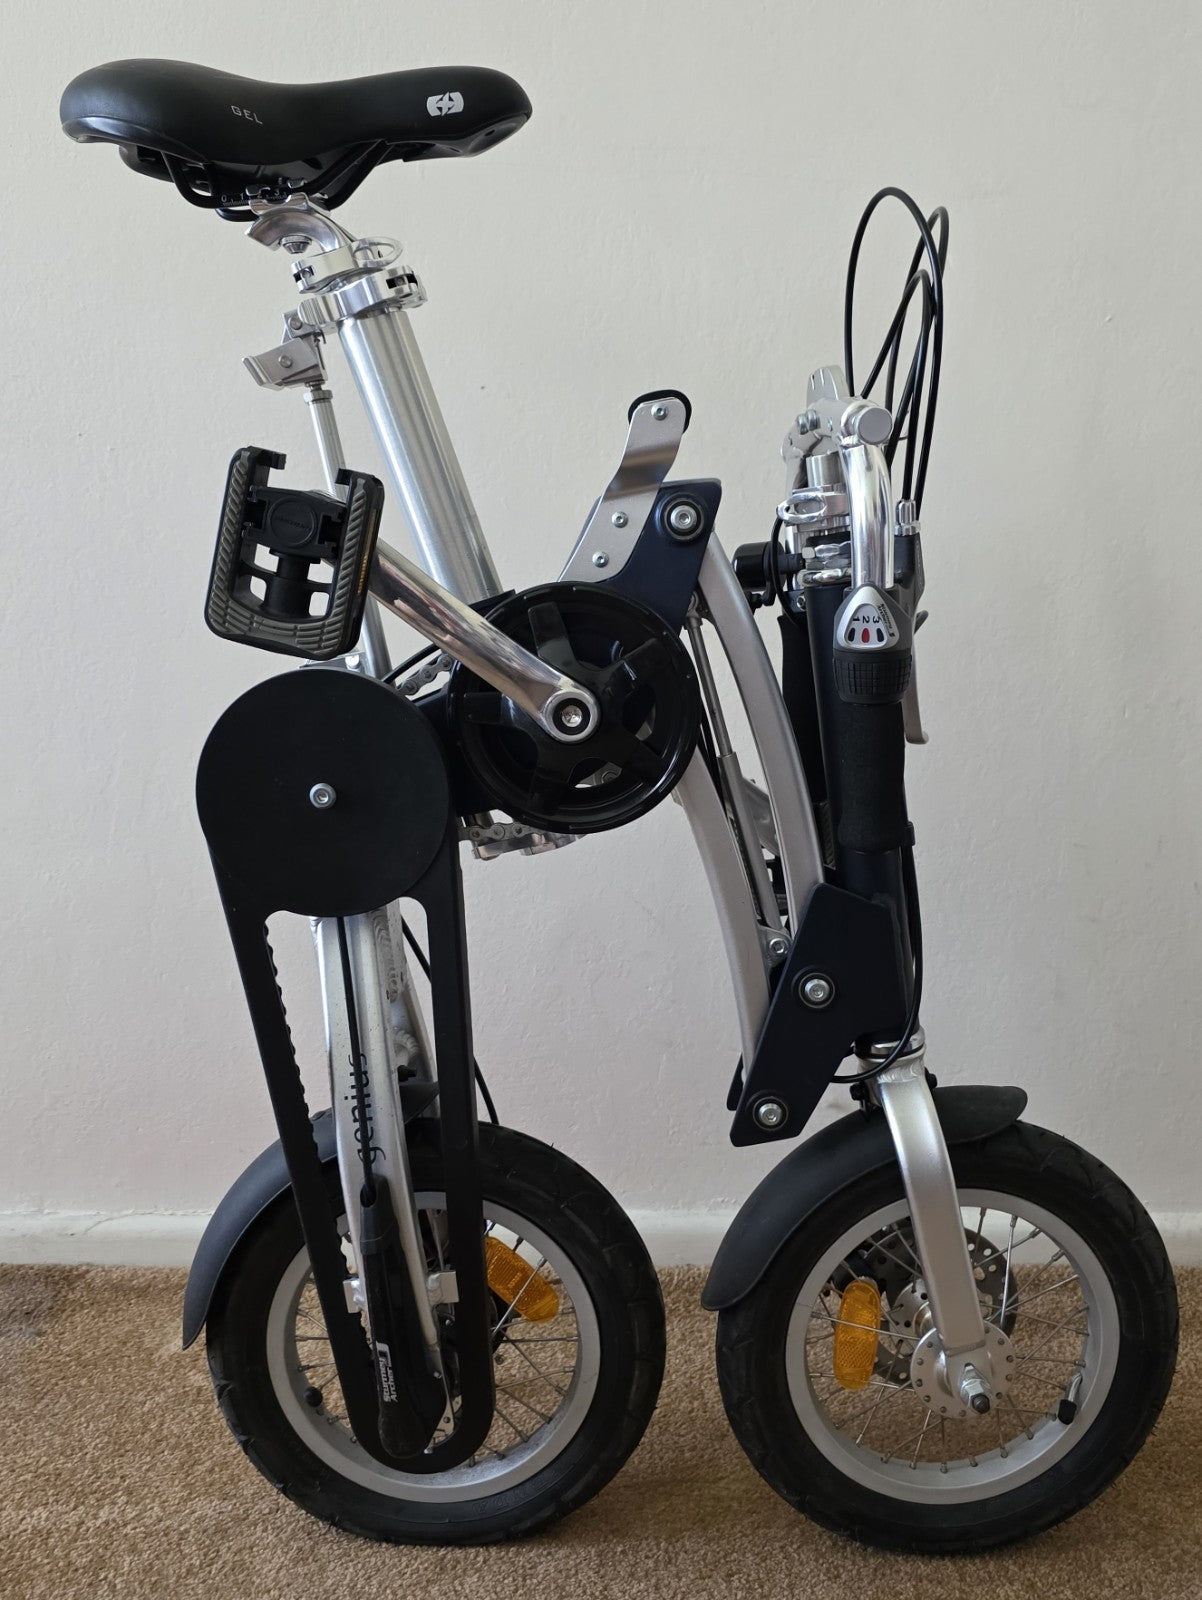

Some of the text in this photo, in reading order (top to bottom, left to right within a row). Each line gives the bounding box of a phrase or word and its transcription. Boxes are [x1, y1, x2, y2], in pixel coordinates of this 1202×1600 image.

[231, 105, 263, 125] GEL
[862, 616, 870, 624] 2
[872, 616, 880, 624] 3
